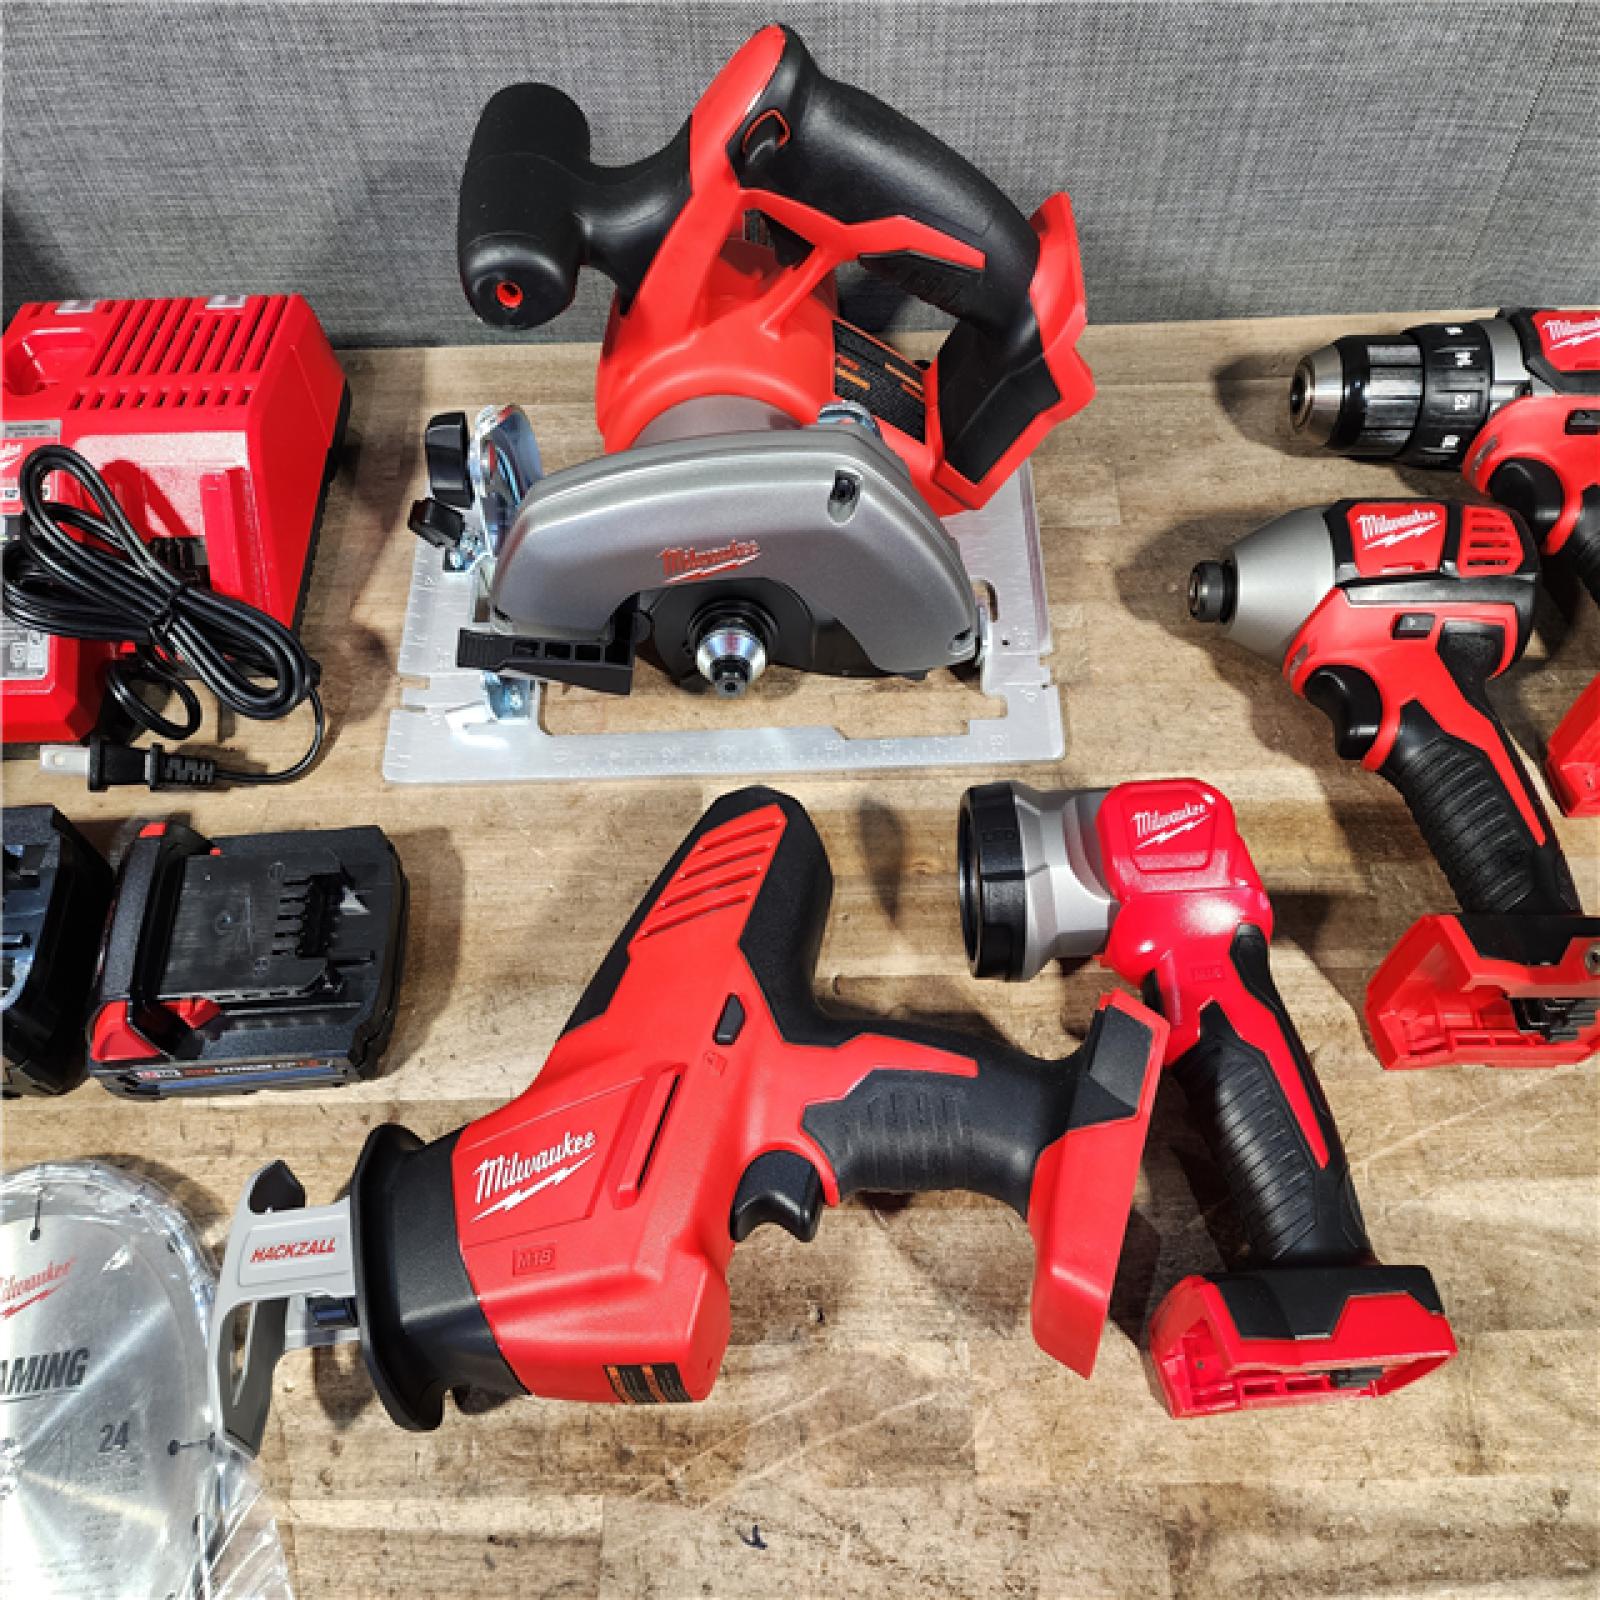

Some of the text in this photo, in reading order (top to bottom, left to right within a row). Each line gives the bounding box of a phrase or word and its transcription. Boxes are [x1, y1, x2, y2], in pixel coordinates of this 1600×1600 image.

[1356, 507, 1436, 539] Milwaukee
[1130, 801, 1207, 839] Milwaukee
[471, 1131, 597, 1206] Milwaukee
[249, 1236, 336, 1263] HACKZALL
[98, 1420, 129, 1453] 24
